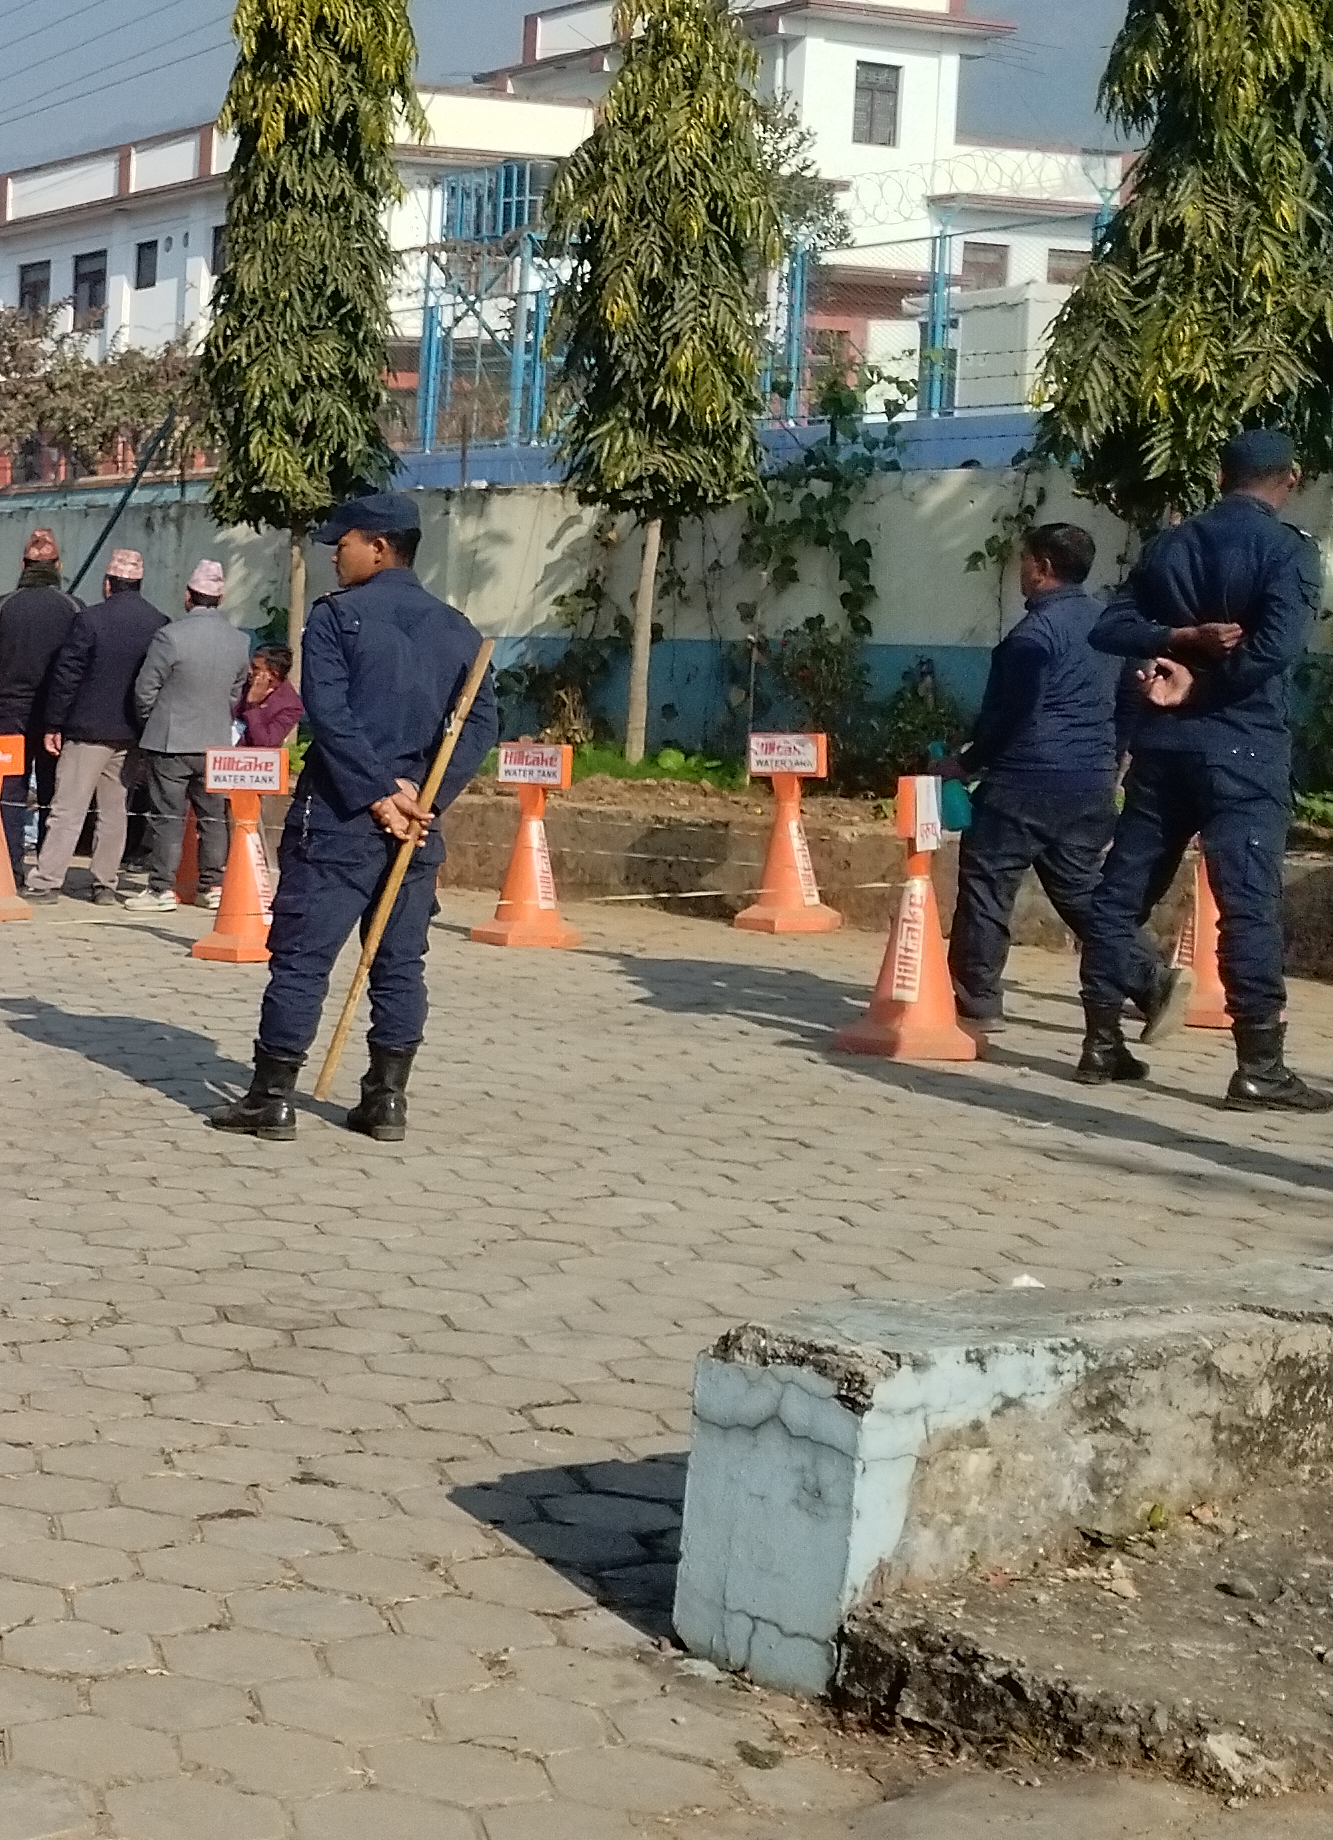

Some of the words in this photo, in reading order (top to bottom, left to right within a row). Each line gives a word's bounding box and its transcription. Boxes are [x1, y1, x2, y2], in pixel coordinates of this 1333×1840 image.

[212, 756, 274, 772] Hilltake
[504, 750, 558, 767] Hilltake
[213, 775, 246, 784] WATER
[249, 775, 275, 785] TANK
[504, 769, 533, 778] WATER
[537, 769, 557, 779] TANK
[895, 893, 924, 992] Hilltake
